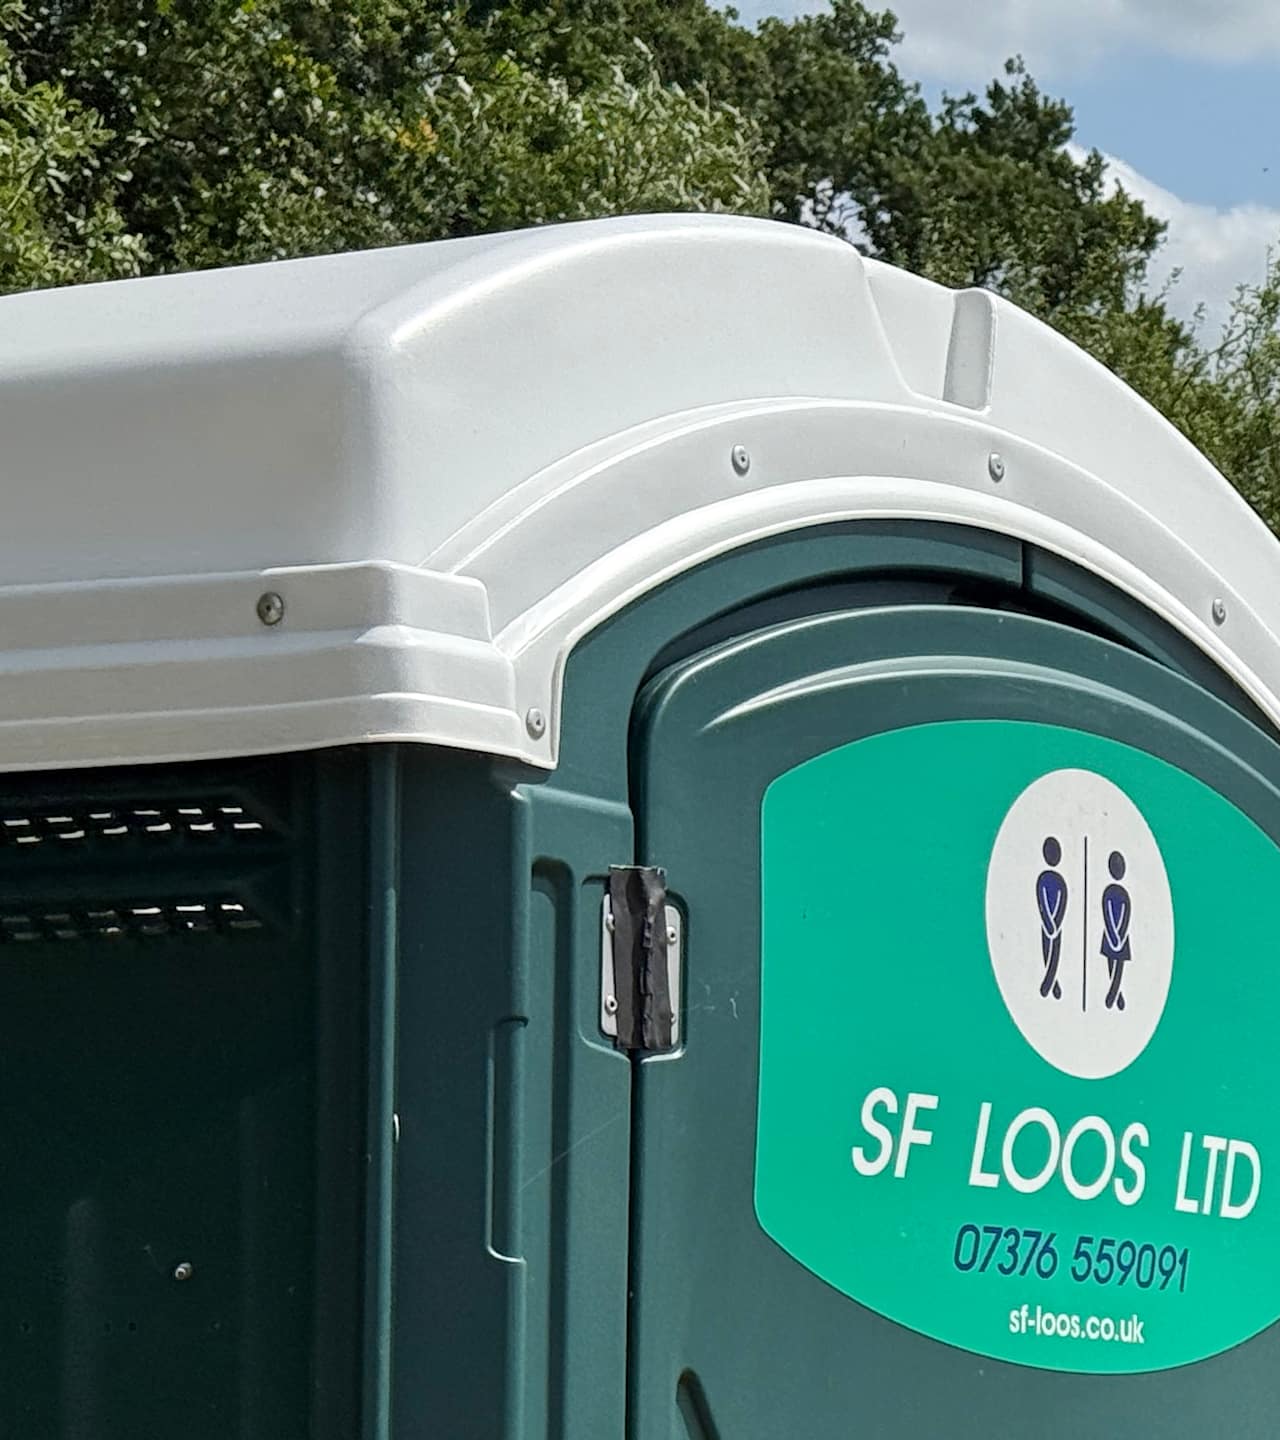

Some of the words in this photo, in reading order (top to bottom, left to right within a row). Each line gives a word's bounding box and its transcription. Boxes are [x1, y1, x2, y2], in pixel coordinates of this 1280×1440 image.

[851, 1087, 939, 1178] SF
[968, 1102, 1150, 1206] LOOS
[1175, 1131, 1262, 1219] LTD
[953, 1224, 1059, 1279] 07376
[1071, 1236, 1190, 1292] 559091
[1009, 1305, 1144, 1343] sf-loos.co.uk
